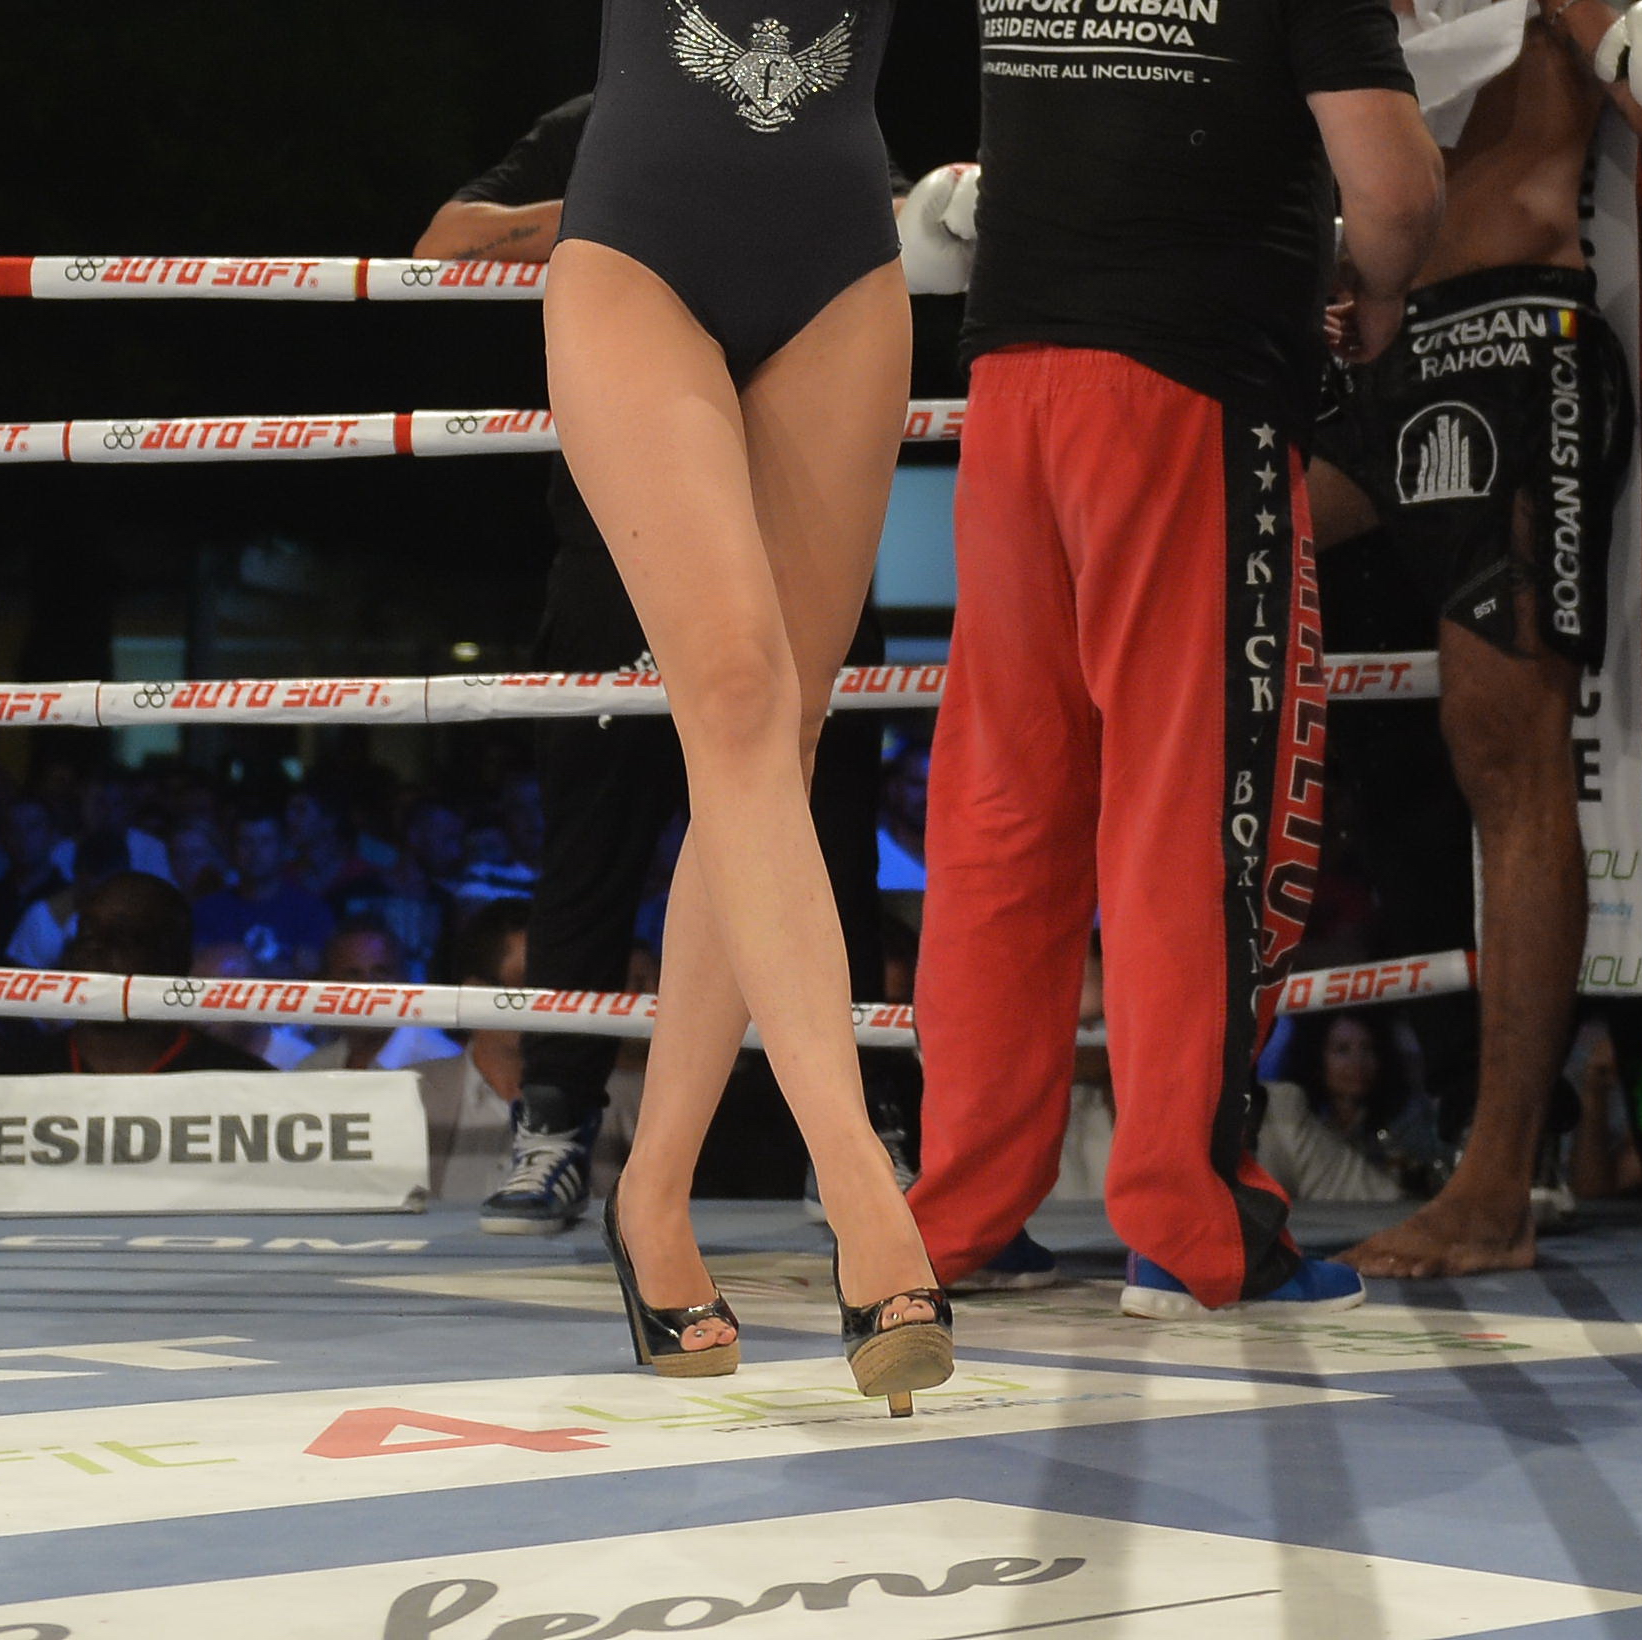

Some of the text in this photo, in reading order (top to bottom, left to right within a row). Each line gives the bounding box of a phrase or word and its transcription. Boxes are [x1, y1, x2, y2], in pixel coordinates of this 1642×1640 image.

[984, 16, 1195, 47] RESIDENCE RAHOVA
[1061, 64, 1088, 80] ALL
[1092, 64, 1195, 84] INCLUSIVE
[102, 257, 208, 285] AUTO
[438, 260, 547, 287] AUTO
[1420, 341, 1531, 381] RAHOVA
[141, 421, 248, 450] AUTO
[1551, 343, 1582, 636] BOGDAN STOICA
[1473, 598, 1497, 619] BST
[1245, 549, 1276, 712] KICK
[840, 666, 948, 692] AUTO
[171, 681, 277, 709] AUTO
[200, 982, 309, 1012] AUTO
